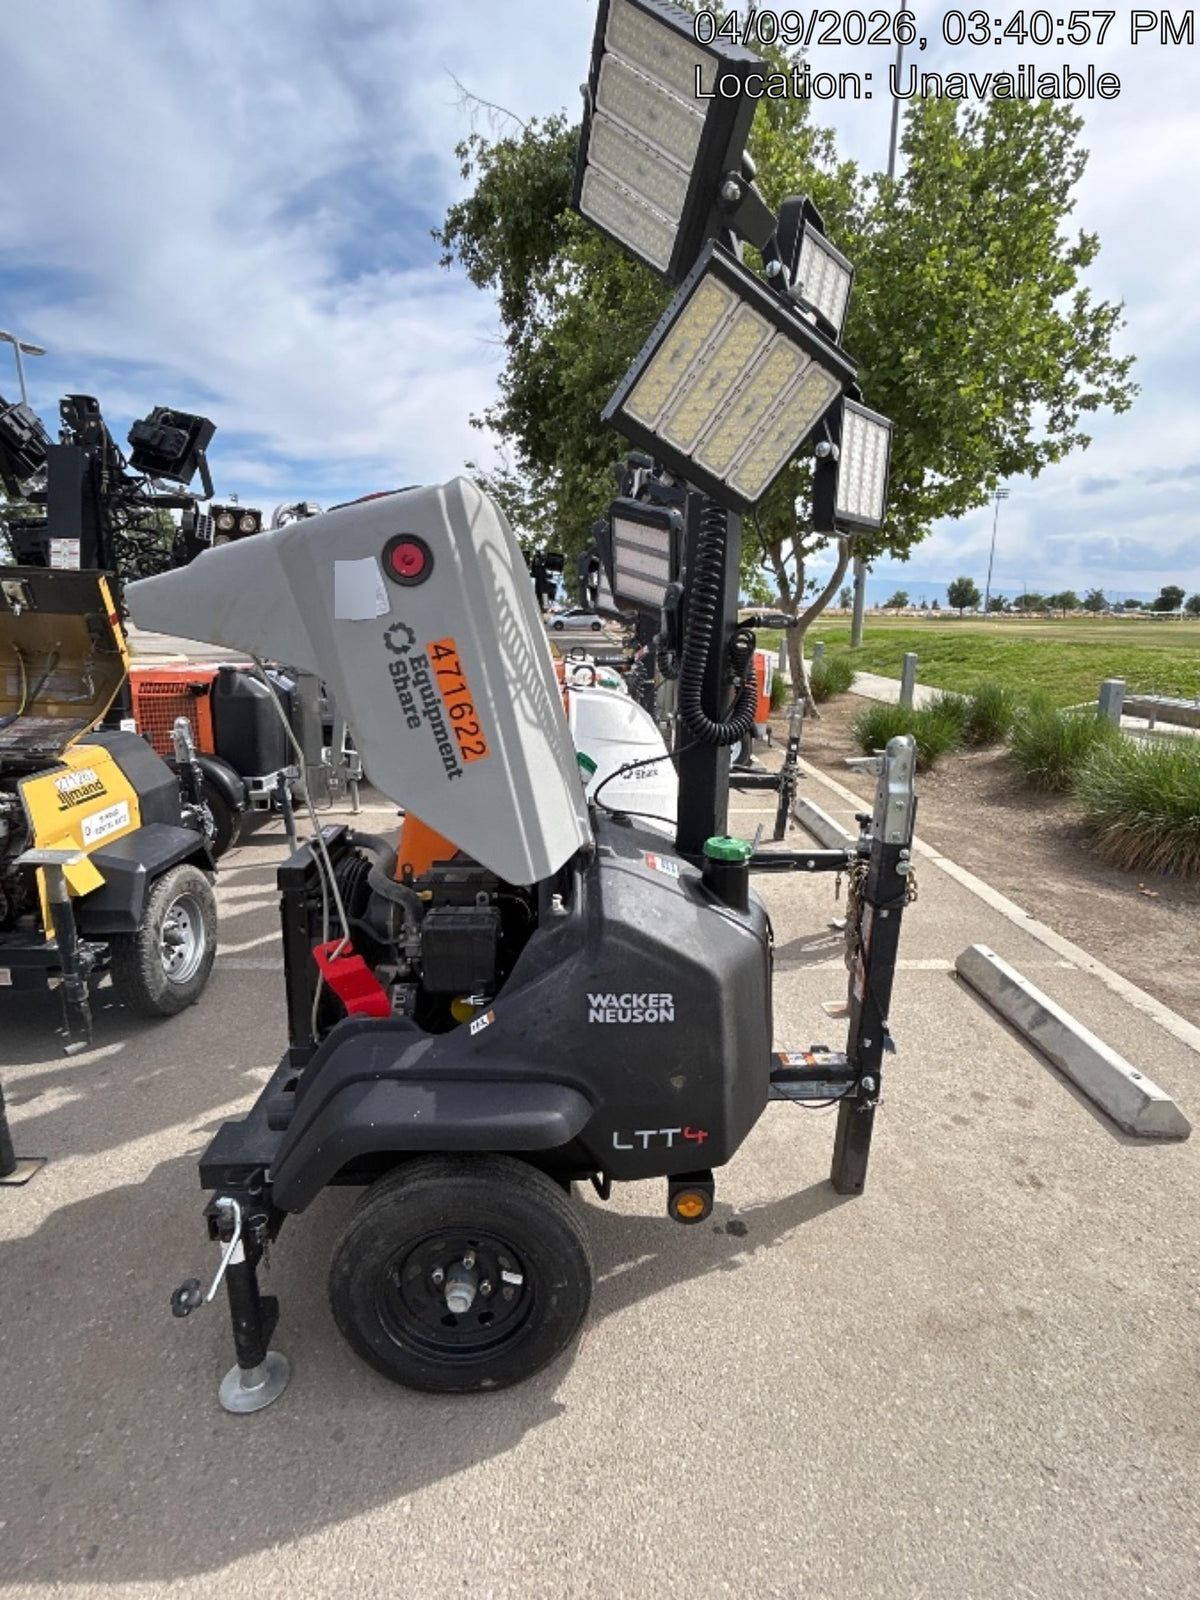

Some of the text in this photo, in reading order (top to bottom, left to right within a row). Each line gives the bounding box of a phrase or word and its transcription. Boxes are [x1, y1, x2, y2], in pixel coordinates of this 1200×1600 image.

[389, 660, 421, 730] Share
[409, 653, 463, 781] Equipment
[432, 644, 486, 760] 471622
[586, 993, 675, 1008] WACKER
[588, 1008, 675, 1023] NEUSON
[612, 1126, 708, 1149] LTT4
